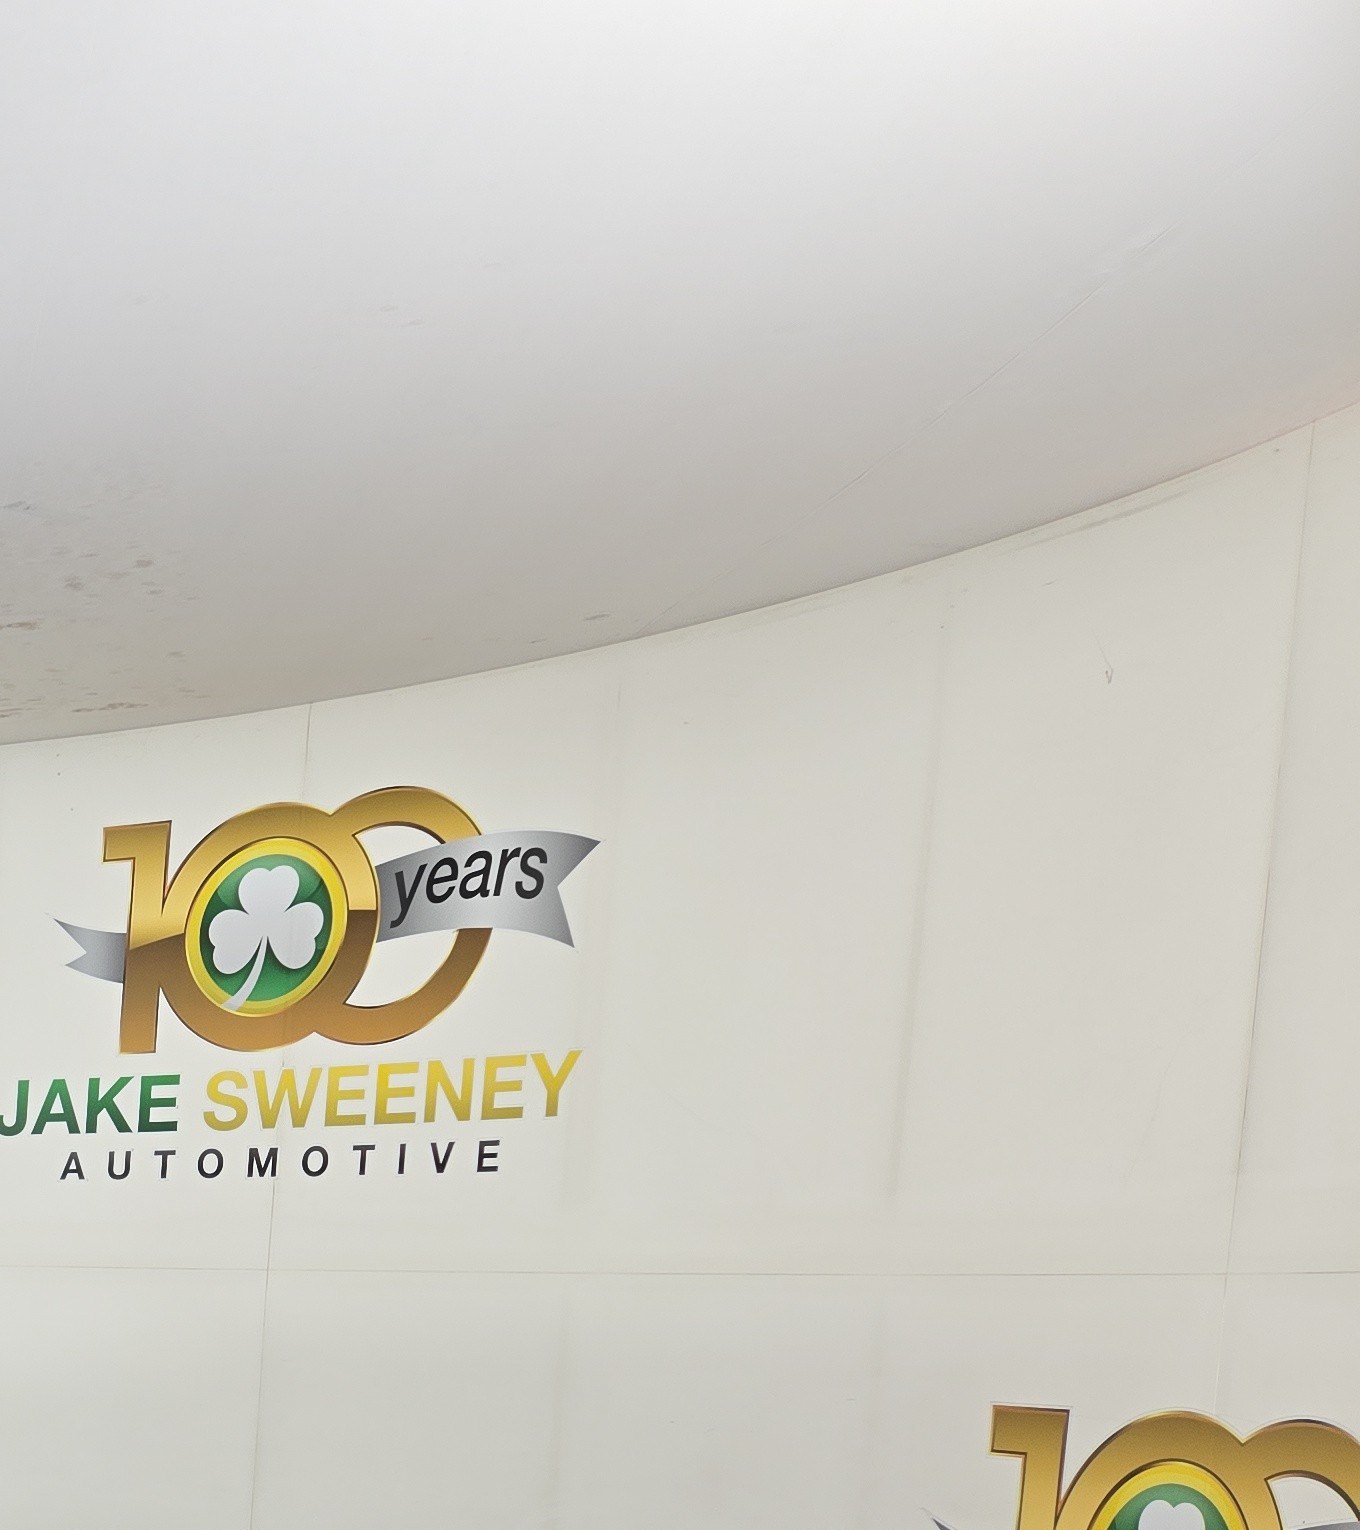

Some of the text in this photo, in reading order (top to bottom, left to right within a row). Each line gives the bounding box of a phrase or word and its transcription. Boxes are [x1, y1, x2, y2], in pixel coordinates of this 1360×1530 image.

[389, 845, 549, 929] years
[201, 1050, 583, 1132] SWEENEY
[60, 1139, 501, 1181] AUTOMOTIVE
